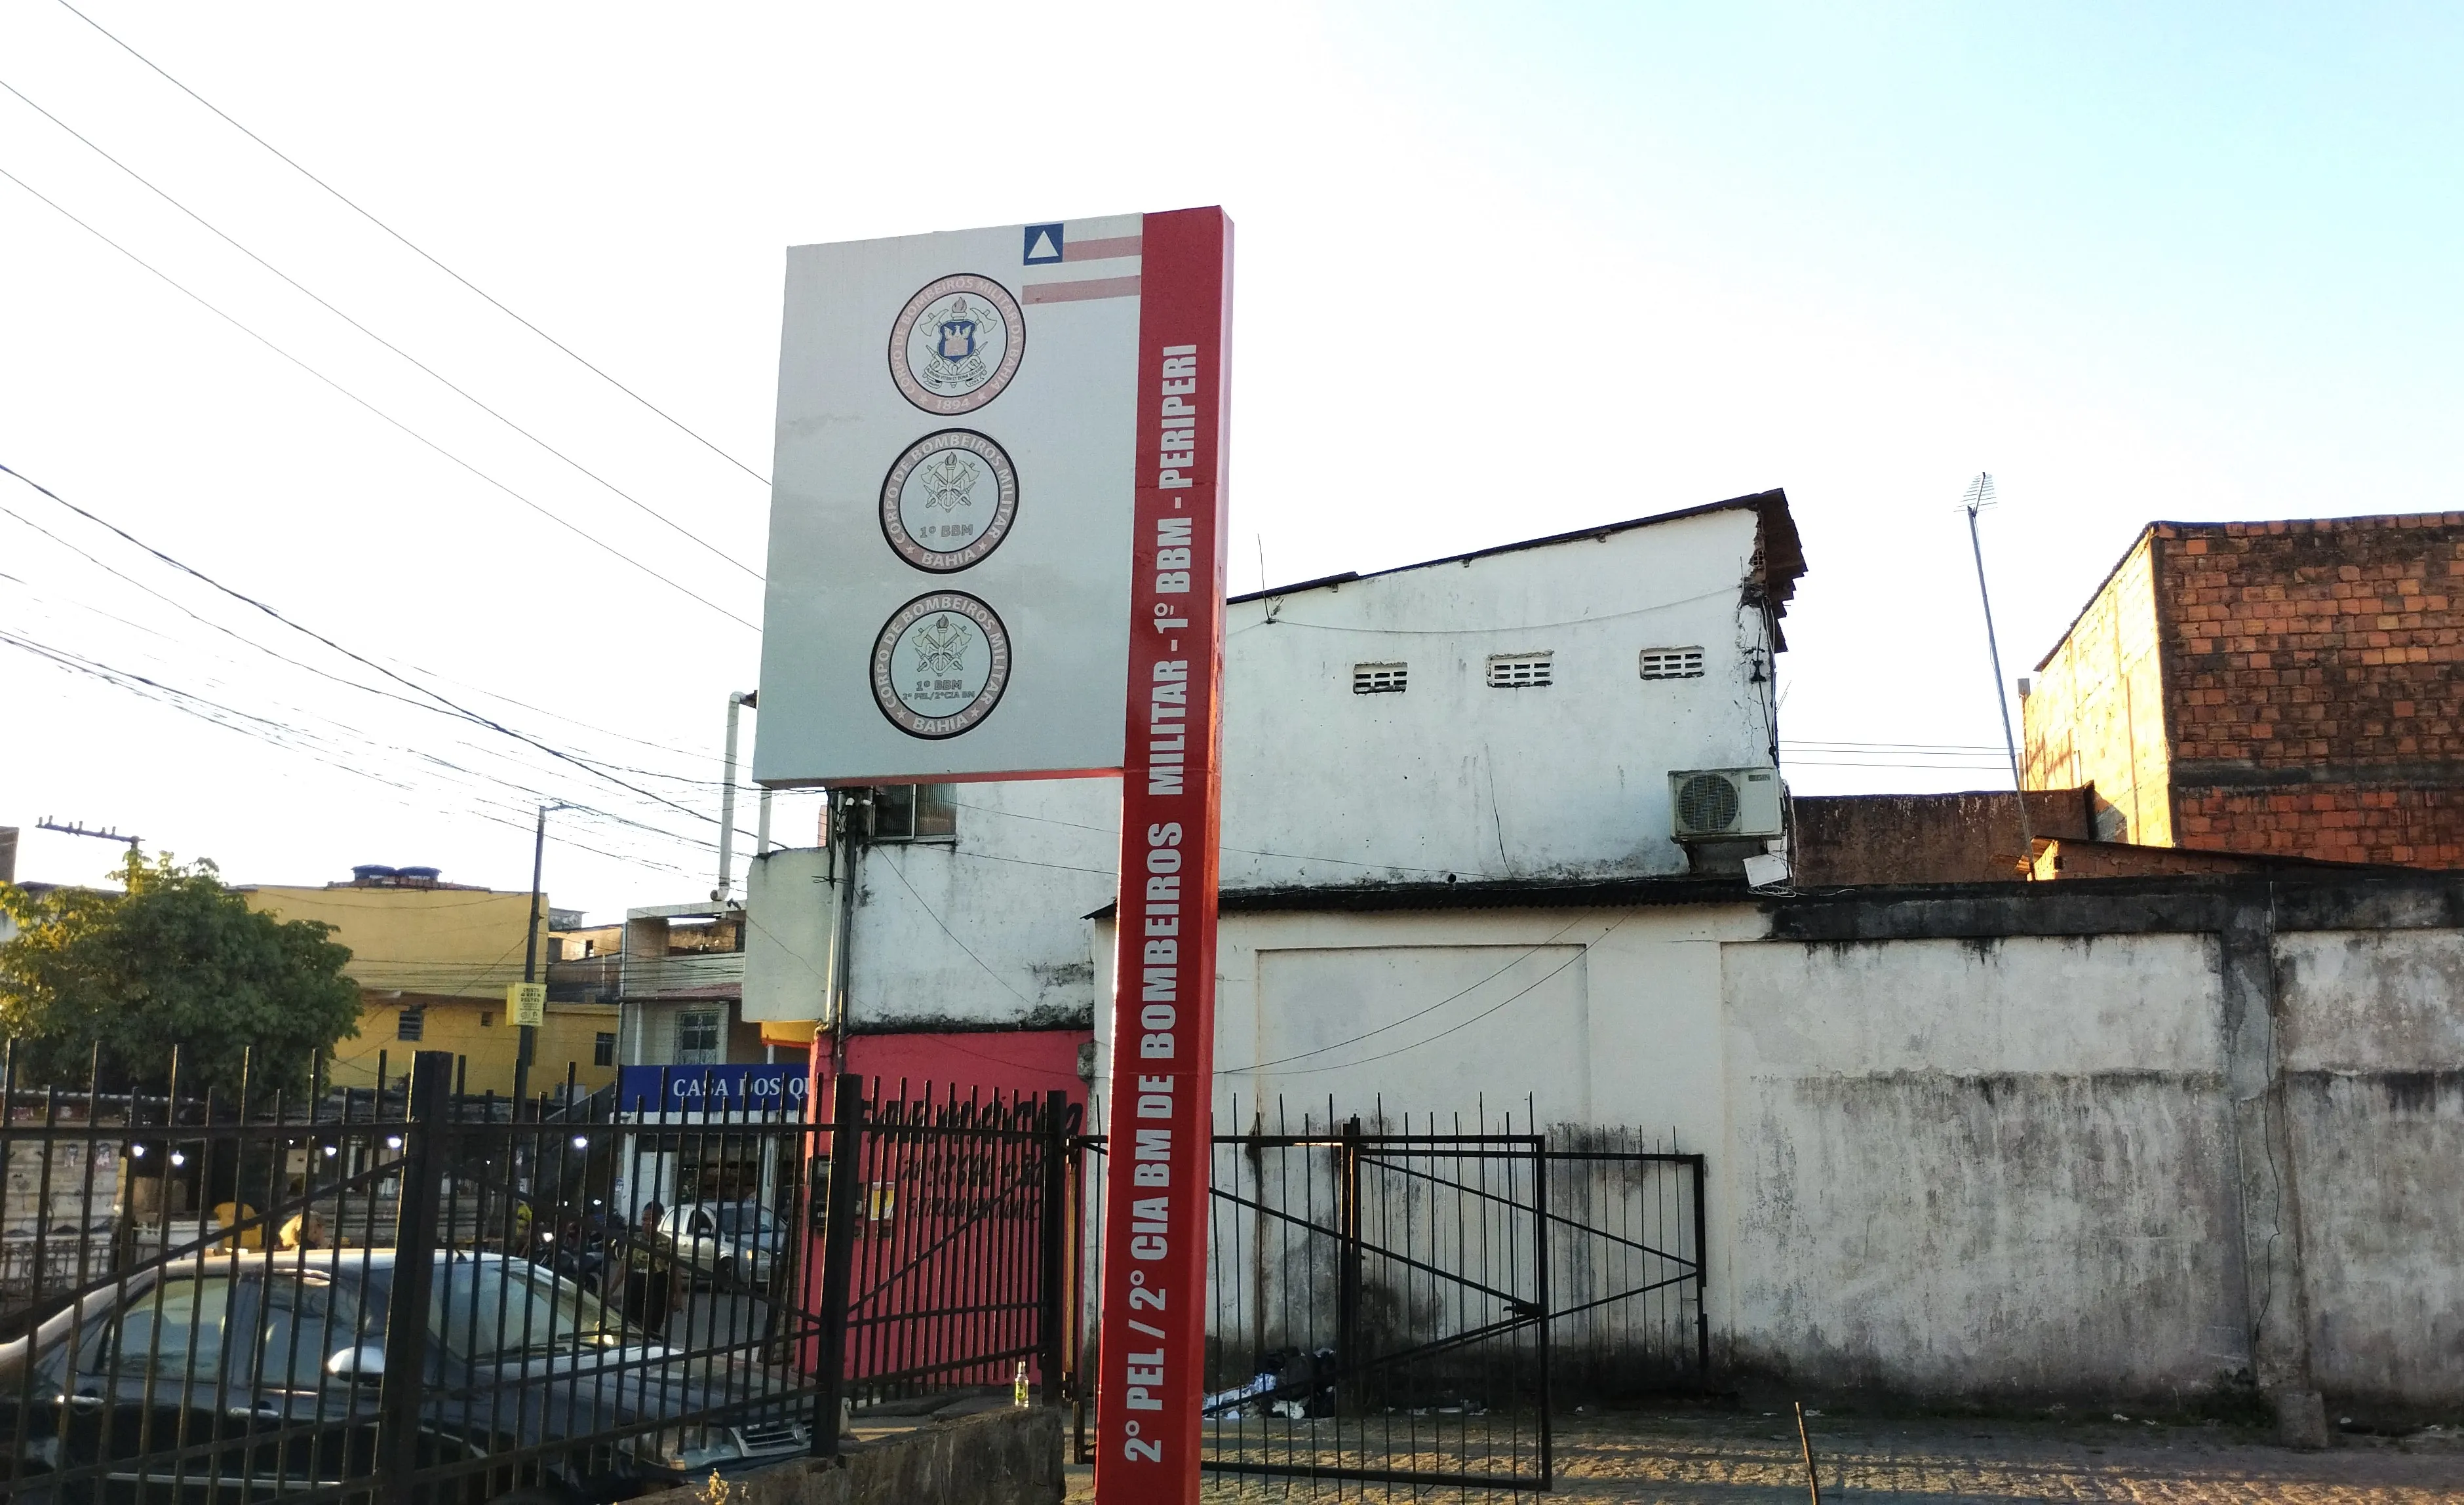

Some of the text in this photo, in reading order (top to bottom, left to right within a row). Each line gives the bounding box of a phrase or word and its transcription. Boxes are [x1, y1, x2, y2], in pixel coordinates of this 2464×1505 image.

[892, 277, 1022, 395] CORPO DE BOMBEIROS MILITAR DA BAHIA
[935, 398, 971, 410] 1894
[1158, 344, 1197, 489] PERIPERI
[886, 435, 1013, 545] CORPO DE BOMBEIROS MILITAR
[921, 549, 977, 567] BAHIA
[941, 524, 973, 538] BBM
[1156, 518, 1192, 594] BBM
[876, 596, 1006, 708] CORPO DE BOMBEIROS MILITAR
[934, 679, 962, 690] BBM
[912, 715, 969, 733] BAHIA
[1148, 659, 1188, 796] MILITAR
[1140, 821, 1183, 1059] BOMBEIROS
[1137, 1074, 1175, 1119] DE
[1133, 1129, 1172, 1187] BM
[1131, 1196, 1169, 1261] CIA
[1127, 1318, 1165, 1339] /
[1125, 1347, 1165, 1411] PEL
